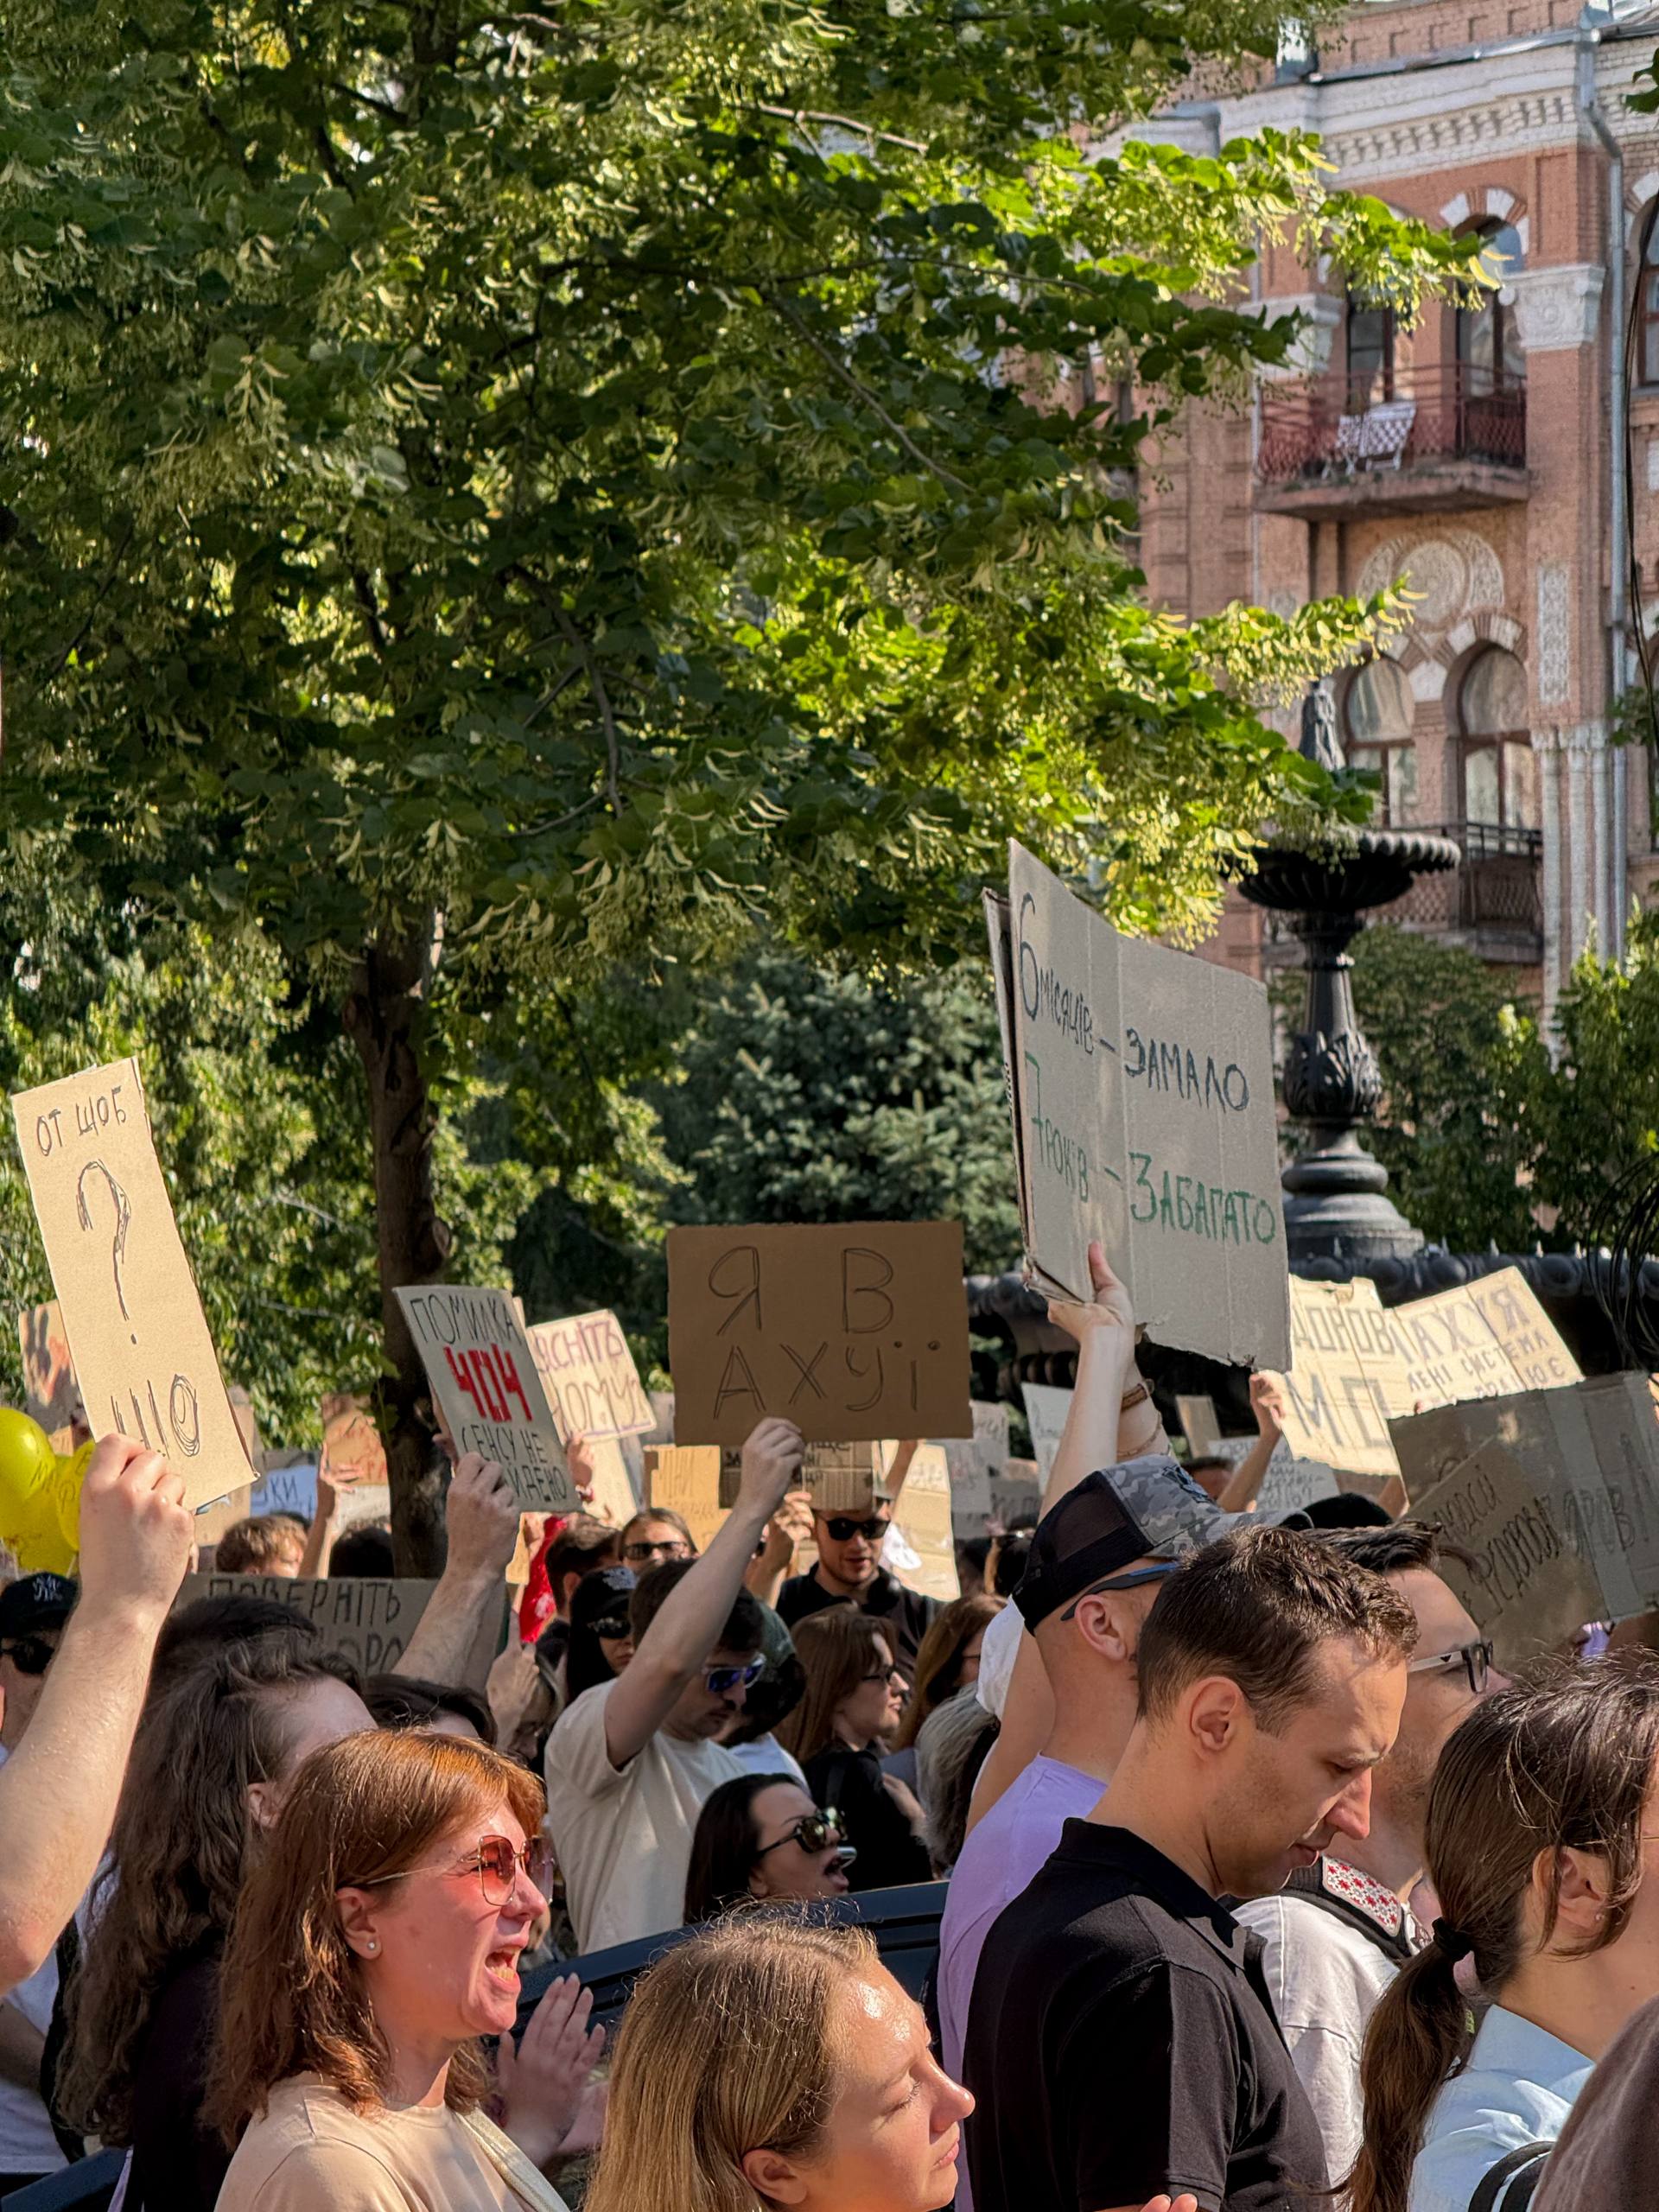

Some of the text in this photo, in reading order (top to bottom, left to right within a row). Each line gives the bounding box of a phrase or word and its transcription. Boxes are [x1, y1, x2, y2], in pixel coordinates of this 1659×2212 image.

[1020, 891, 1039, 1021] 6
[1125, 1028, 1249, 1114] ЗАМАЛО
[36, 1109, 61, 1156] ОТ
[1025, 1051, 1044, 1163] 7
[1128, 1151, 1276, 1245] ЗАБАГАТО
[410, 1294, 523, 1345] ПОМИЛКА
[709, 1245, 893, 1336] Я В
[536, 1320, 624, 1372] ЯСНІТЬ
[443, 1343, 533, 1423] 404
[713, 1341, 941, 1420] АХУЇ
[522, 1432, 548, 1464] НЕ
[504, 1462, 568, 1503] ЙДЕНО
